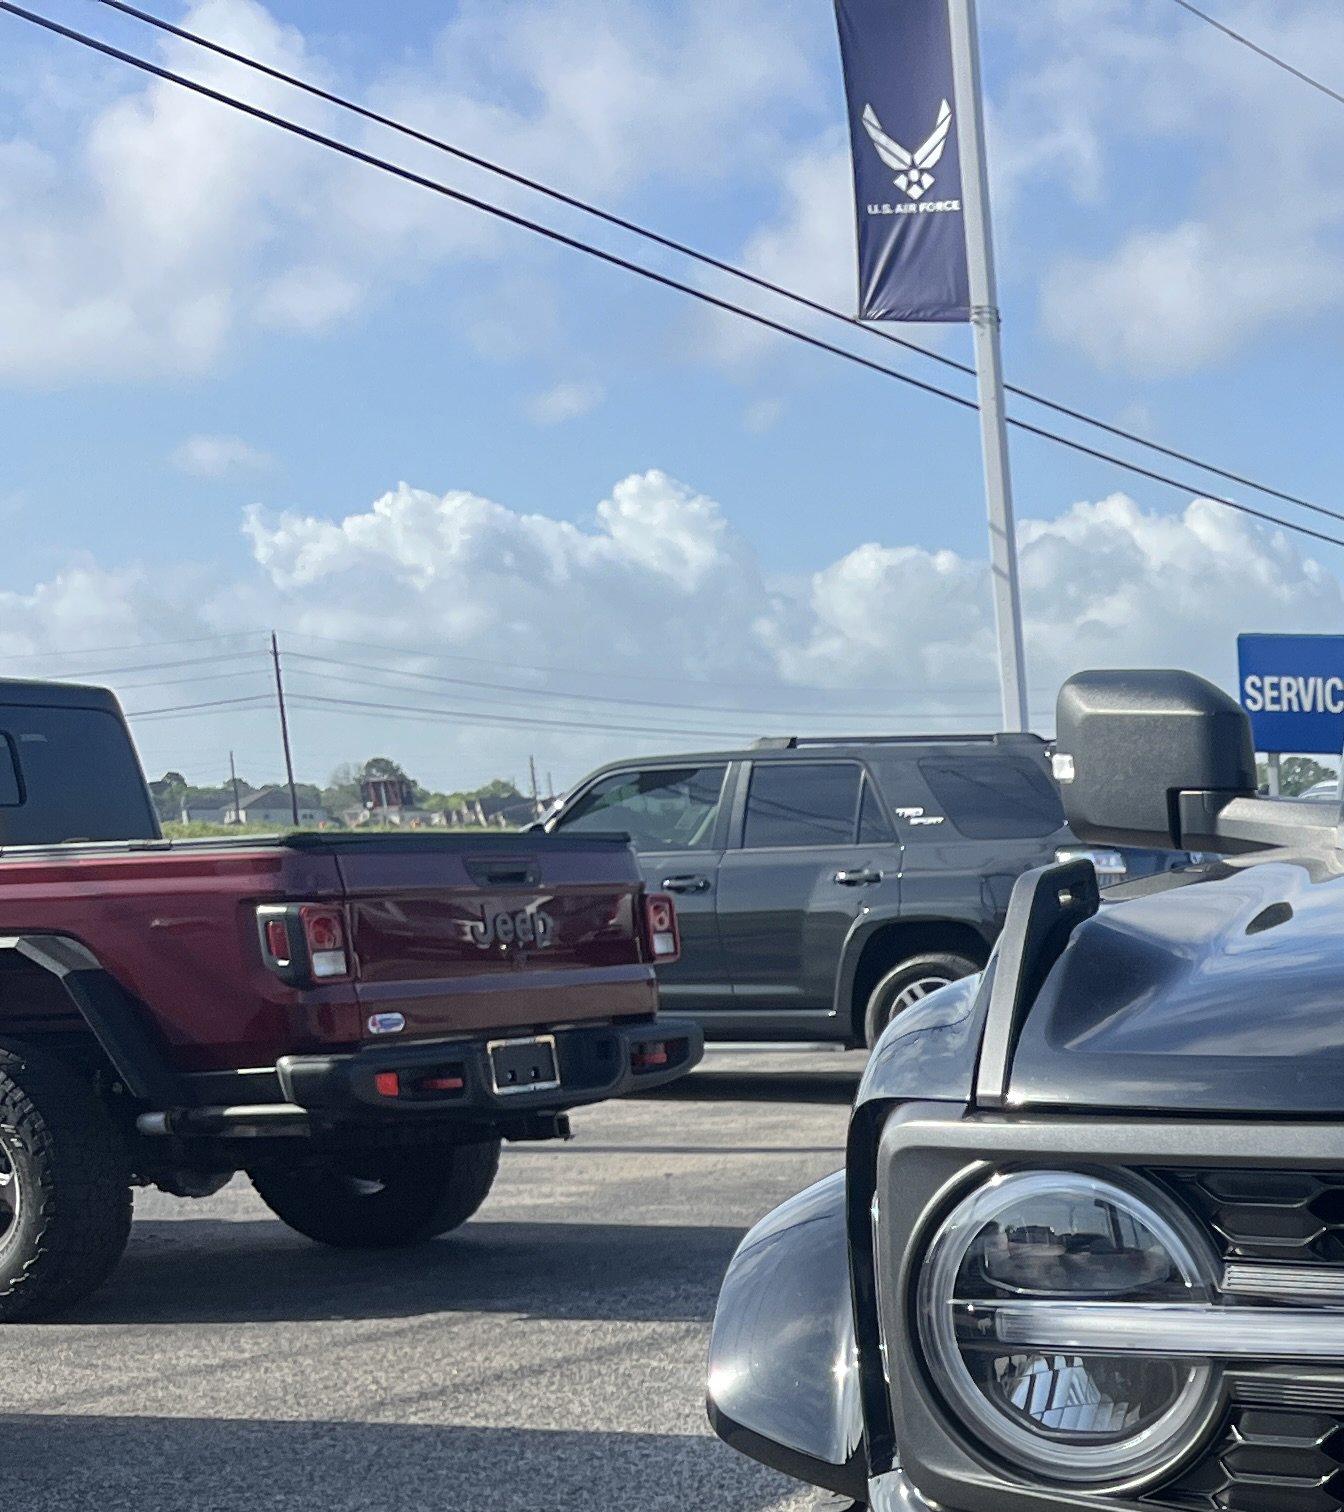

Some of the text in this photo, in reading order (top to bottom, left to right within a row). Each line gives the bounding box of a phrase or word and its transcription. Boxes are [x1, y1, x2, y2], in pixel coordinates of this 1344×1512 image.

[867, 200, 961, 215] U.S. AIR FORCE
[470, 904, 554, 949] Jeep
